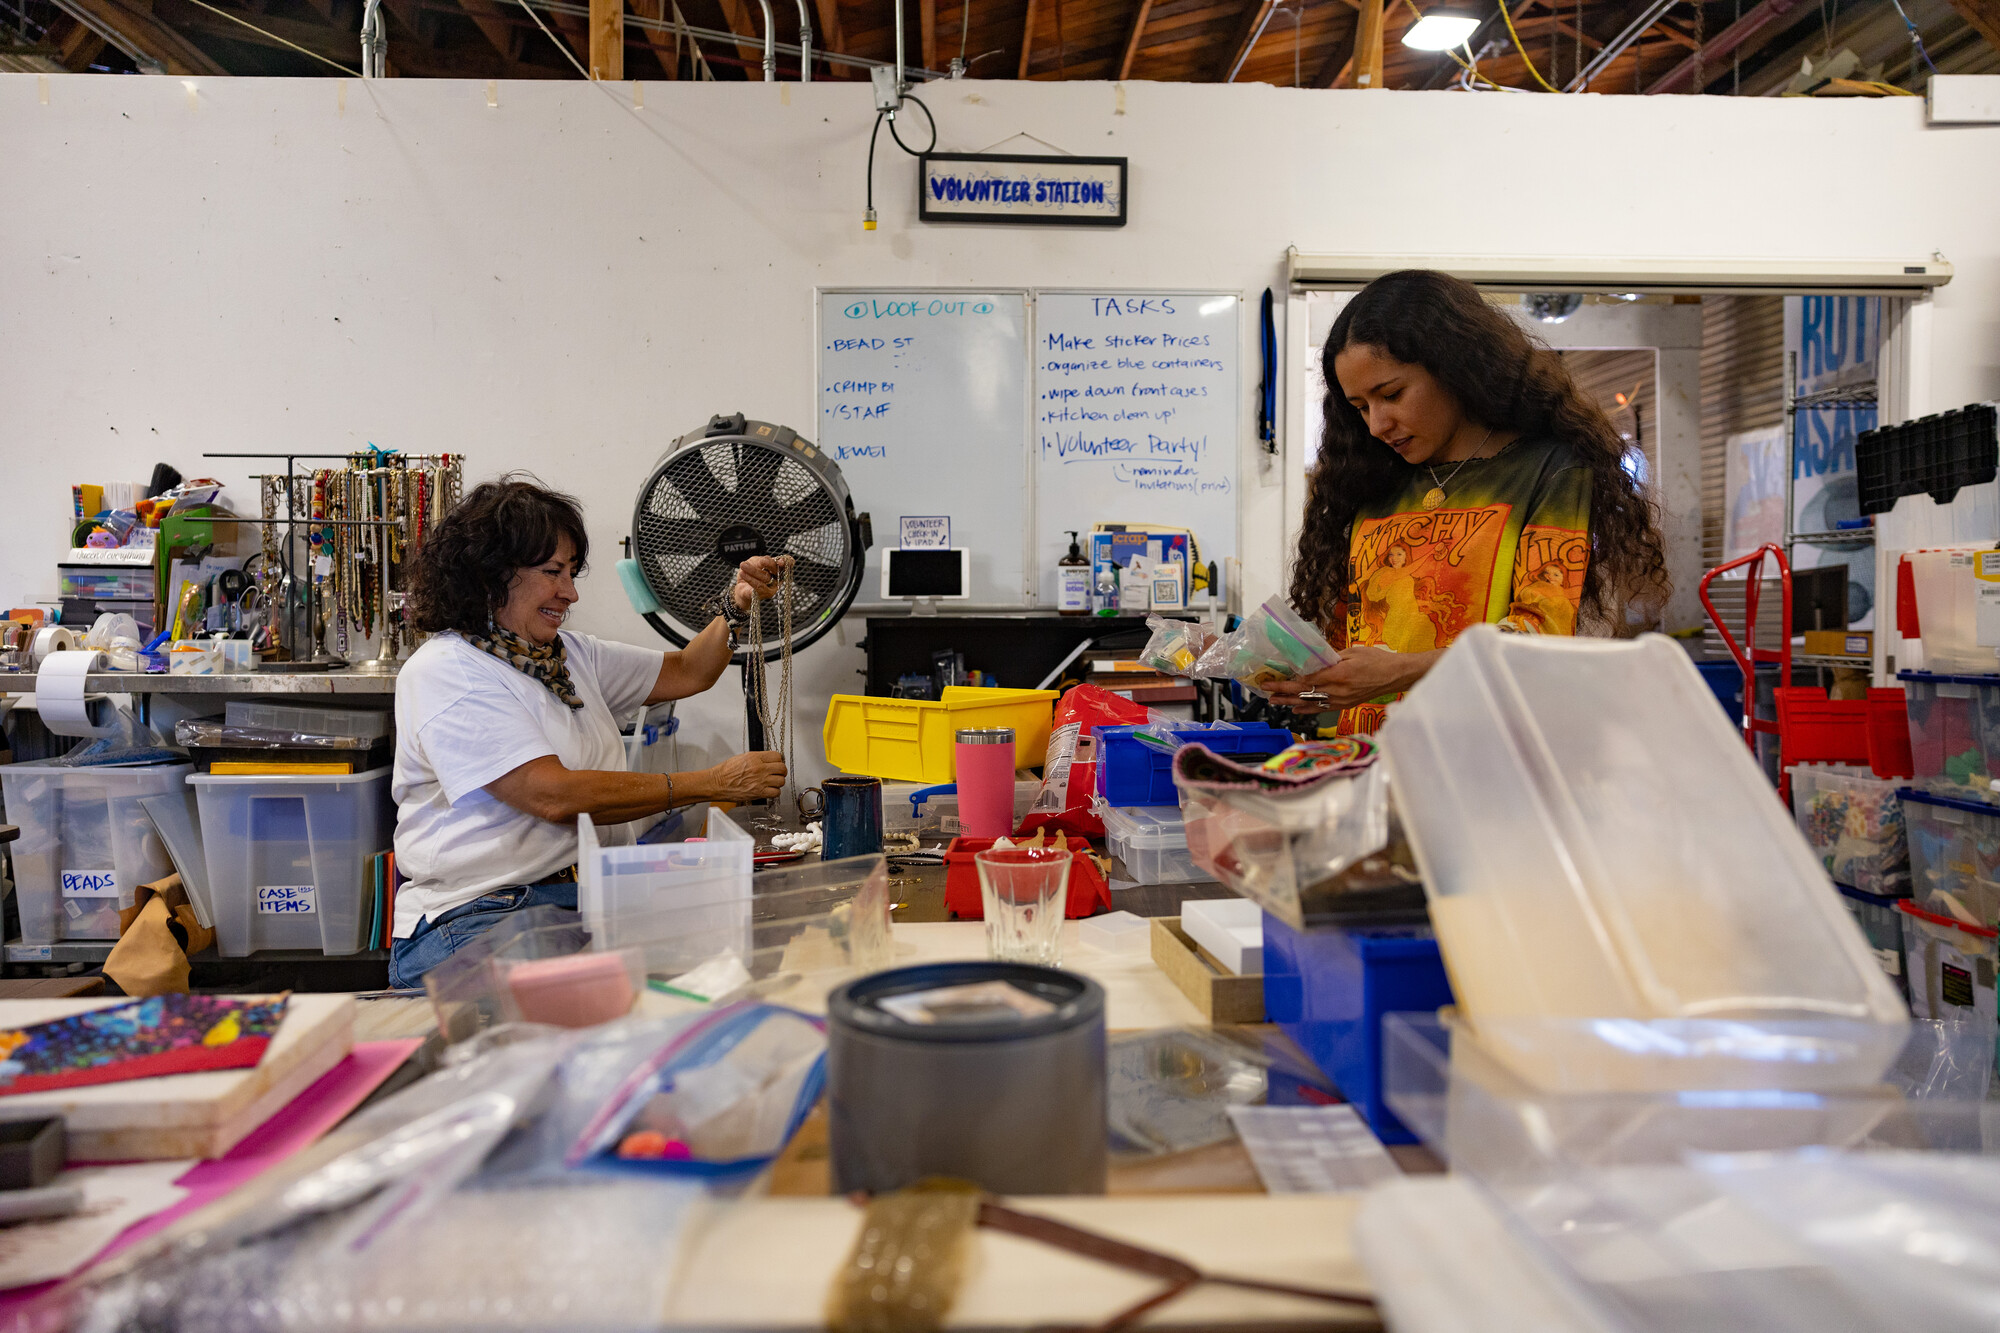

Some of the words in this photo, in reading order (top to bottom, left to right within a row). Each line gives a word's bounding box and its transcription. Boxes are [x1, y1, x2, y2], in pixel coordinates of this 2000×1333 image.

[931, 176, 1031, 203] VOLUNTEER
[1035, 180, 1105, 204] STATION
[1091, 297, 1176, 317] TASKS
[833, 337, 886, 352] BEAD
[1048, 331, 1096, 352] Make
[1117, 357, 1147, 370] blue
[1152, 357, 1224, 372] containers
[833, 380, 878, 396] CRIMP
[1085, 384, 1126, 398] down
[1131, 381, 1168, 397] front
[1055, 430, 1138, 458] Volunteer
[904, 519, 946, 530] VOLUNTEER
[724, 541, 757, 552] PATTON
[62, 873, 115, 891] BEADS
[258, 887, 298, 900] CASE
[259, 899, 311, 913] ITEMS
